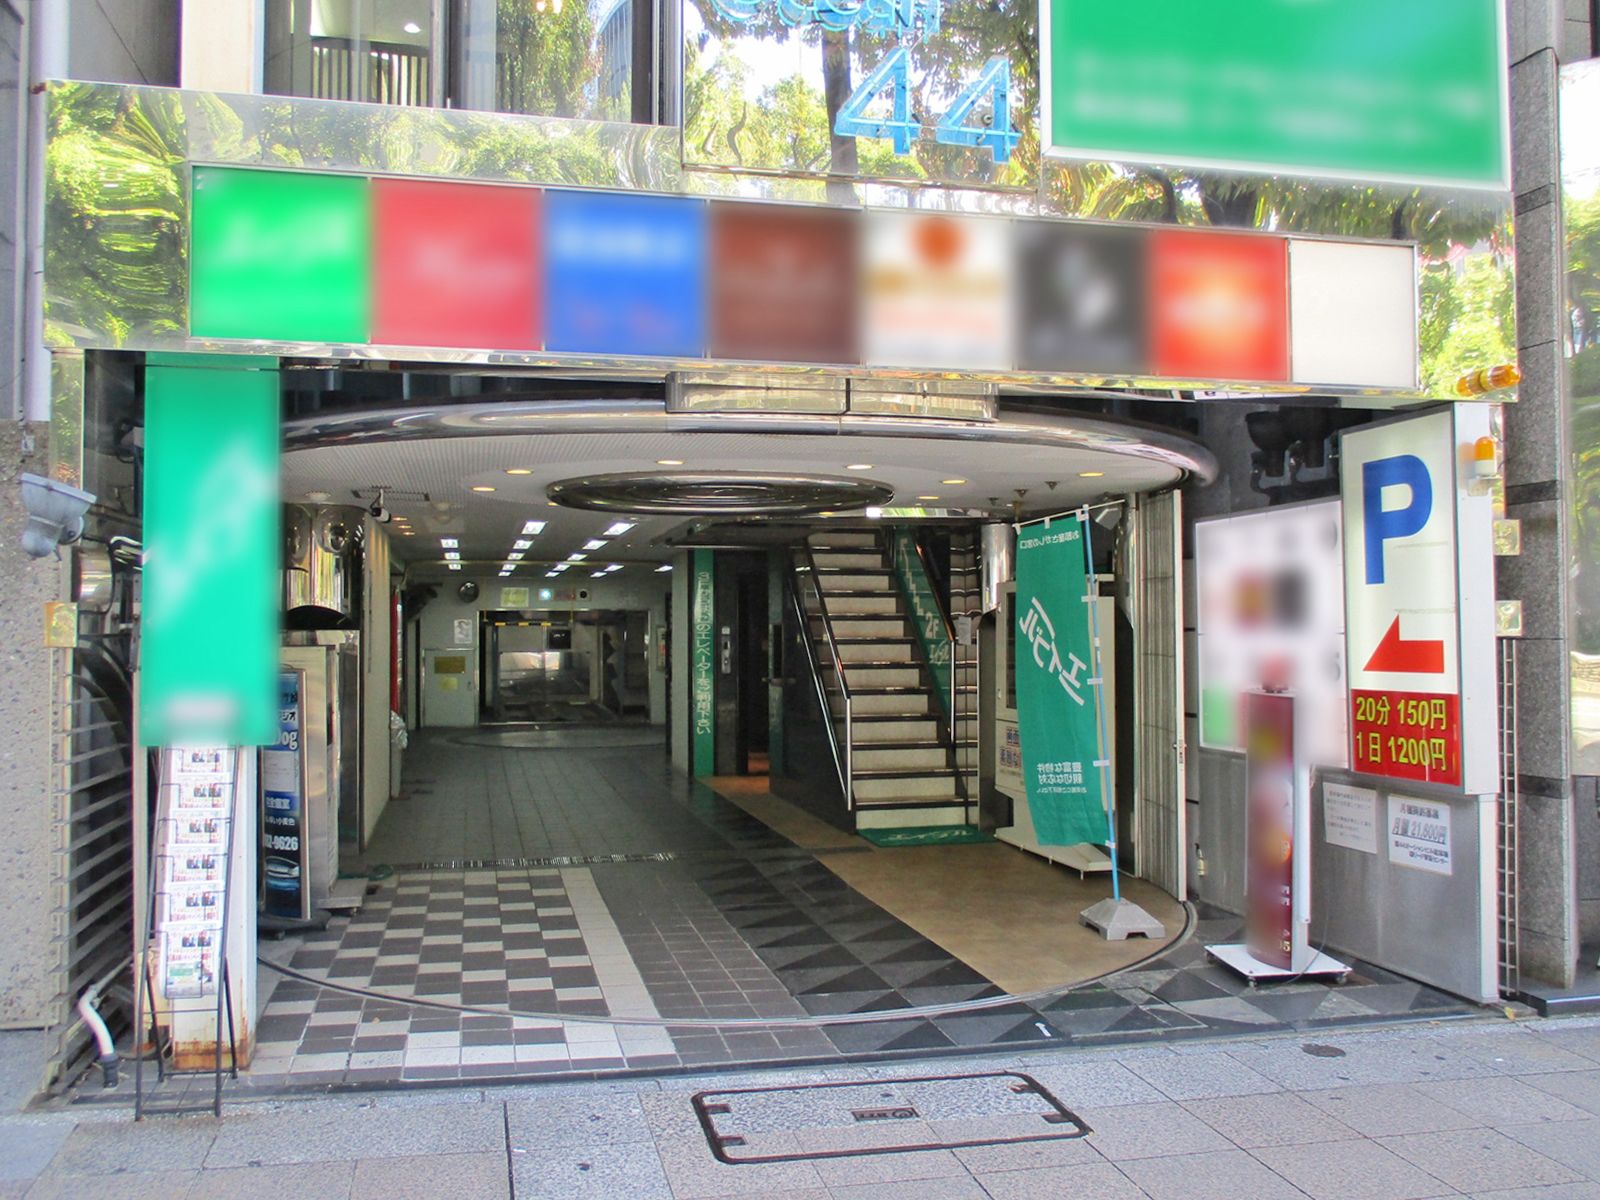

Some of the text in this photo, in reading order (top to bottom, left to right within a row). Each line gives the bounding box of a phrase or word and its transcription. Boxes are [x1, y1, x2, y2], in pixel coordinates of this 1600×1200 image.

[834, 48, 1022, 164] 44
[1362, 454, 1433, 585] P
[1356, 696, 1447, 730] 20分 150円
[1356, 731, 1447, 771] 1日 1200円
